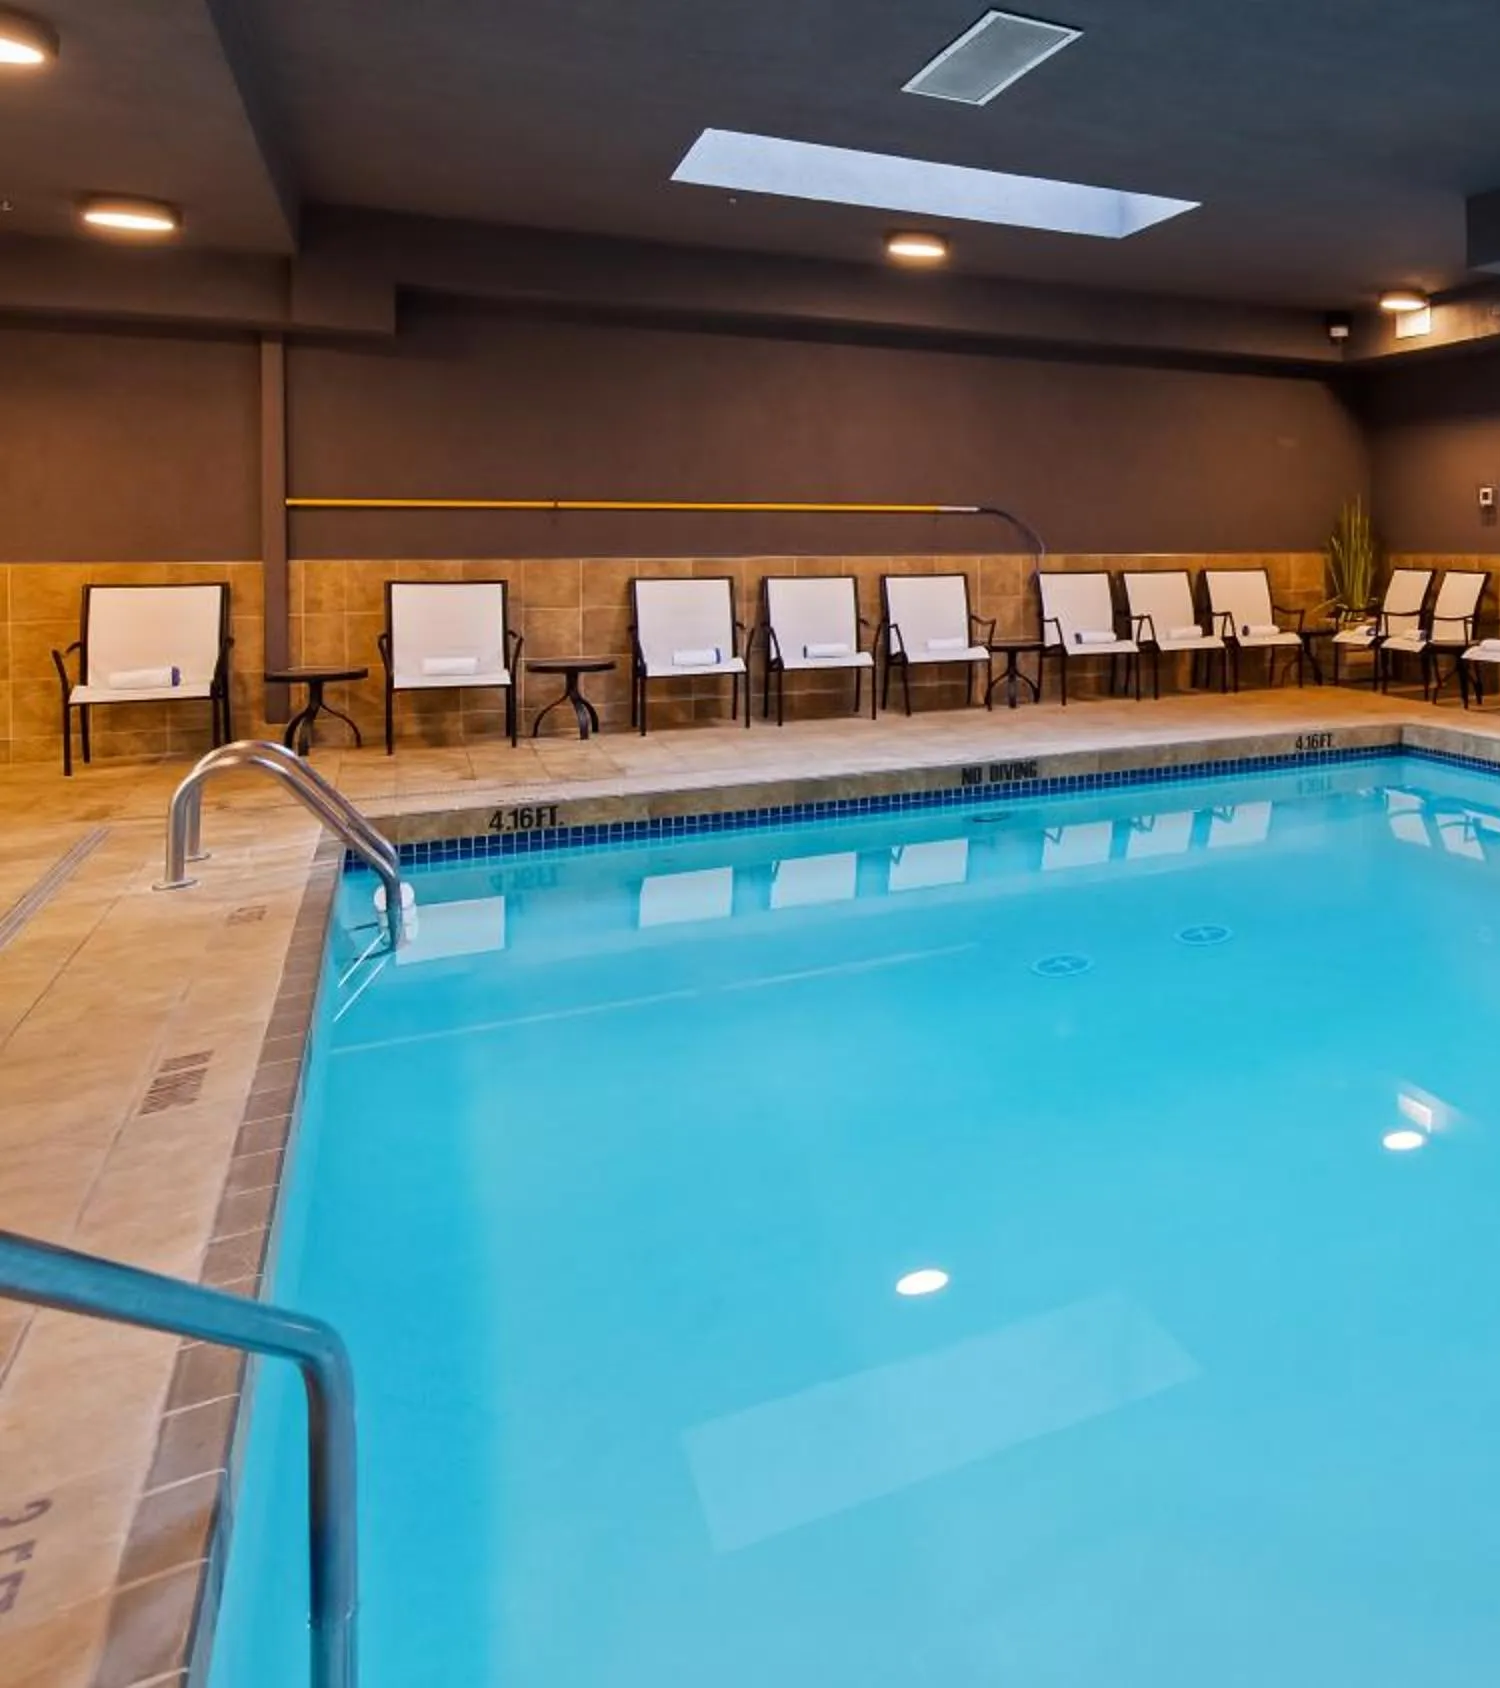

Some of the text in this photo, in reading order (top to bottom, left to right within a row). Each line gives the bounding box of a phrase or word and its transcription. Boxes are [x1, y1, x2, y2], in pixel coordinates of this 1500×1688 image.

[961, 760, 1037, 786] NO DIVING
[488, 804, 565, 832] 4.16FT.
